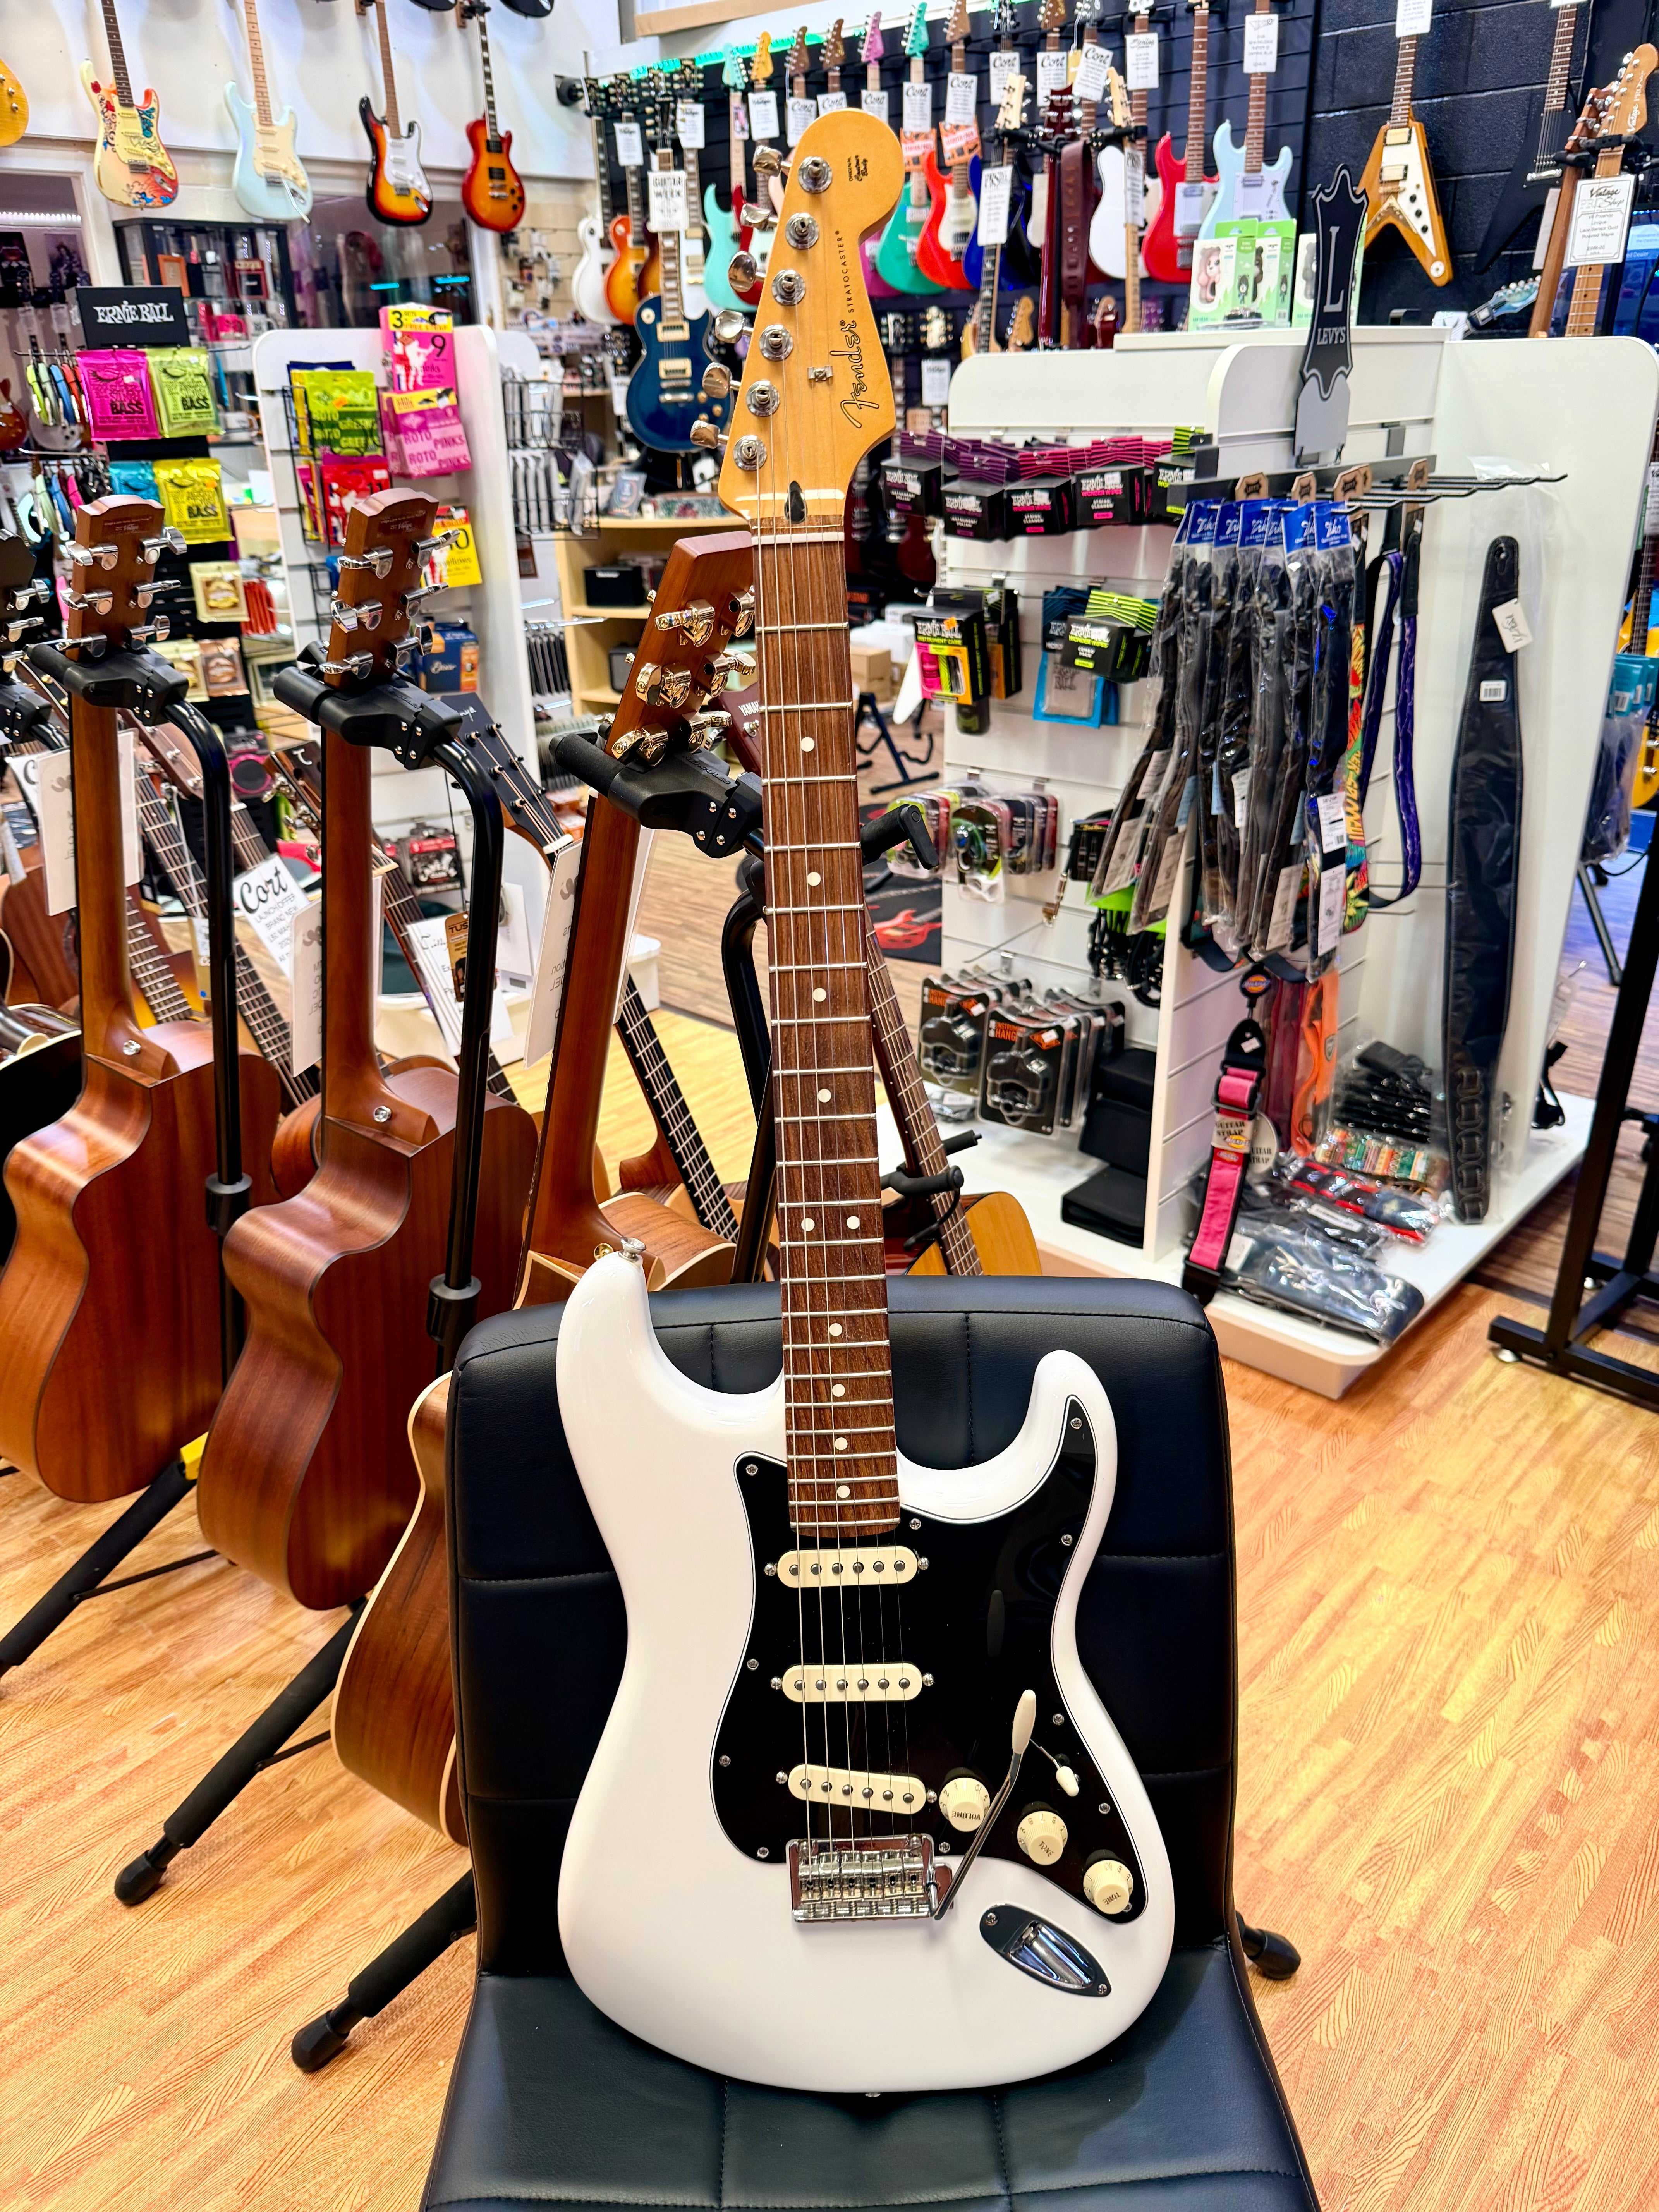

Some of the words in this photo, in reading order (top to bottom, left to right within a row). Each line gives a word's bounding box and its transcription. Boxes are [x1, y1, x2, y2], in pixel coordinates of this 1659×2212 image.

[139, 302, 174, 323] BALL
[392, 311, 403, 328] 3
[431, 335, 446, 357] 9
[830, 319, 879, 428] Fender
[110, 401, 144, 415] BASS
[181, 396, 210, 410] BASS
[187, 504, 219, 519] BASS
[916, 619, 939, 637] ERNIE
[459, 706, 477, 722] nya
[738, 701, 759, 716] YAMA
[240, 866, 288, 914] Cort
[448, 922, 468, 934] TUS
[995, 1028, 1018, 1042] HANG
[951, 1810, 981, 1820] VOLUME
[1039, 1841, 1054, 1857] TONE
[1102, 1891, 1122, 1906] TONE
